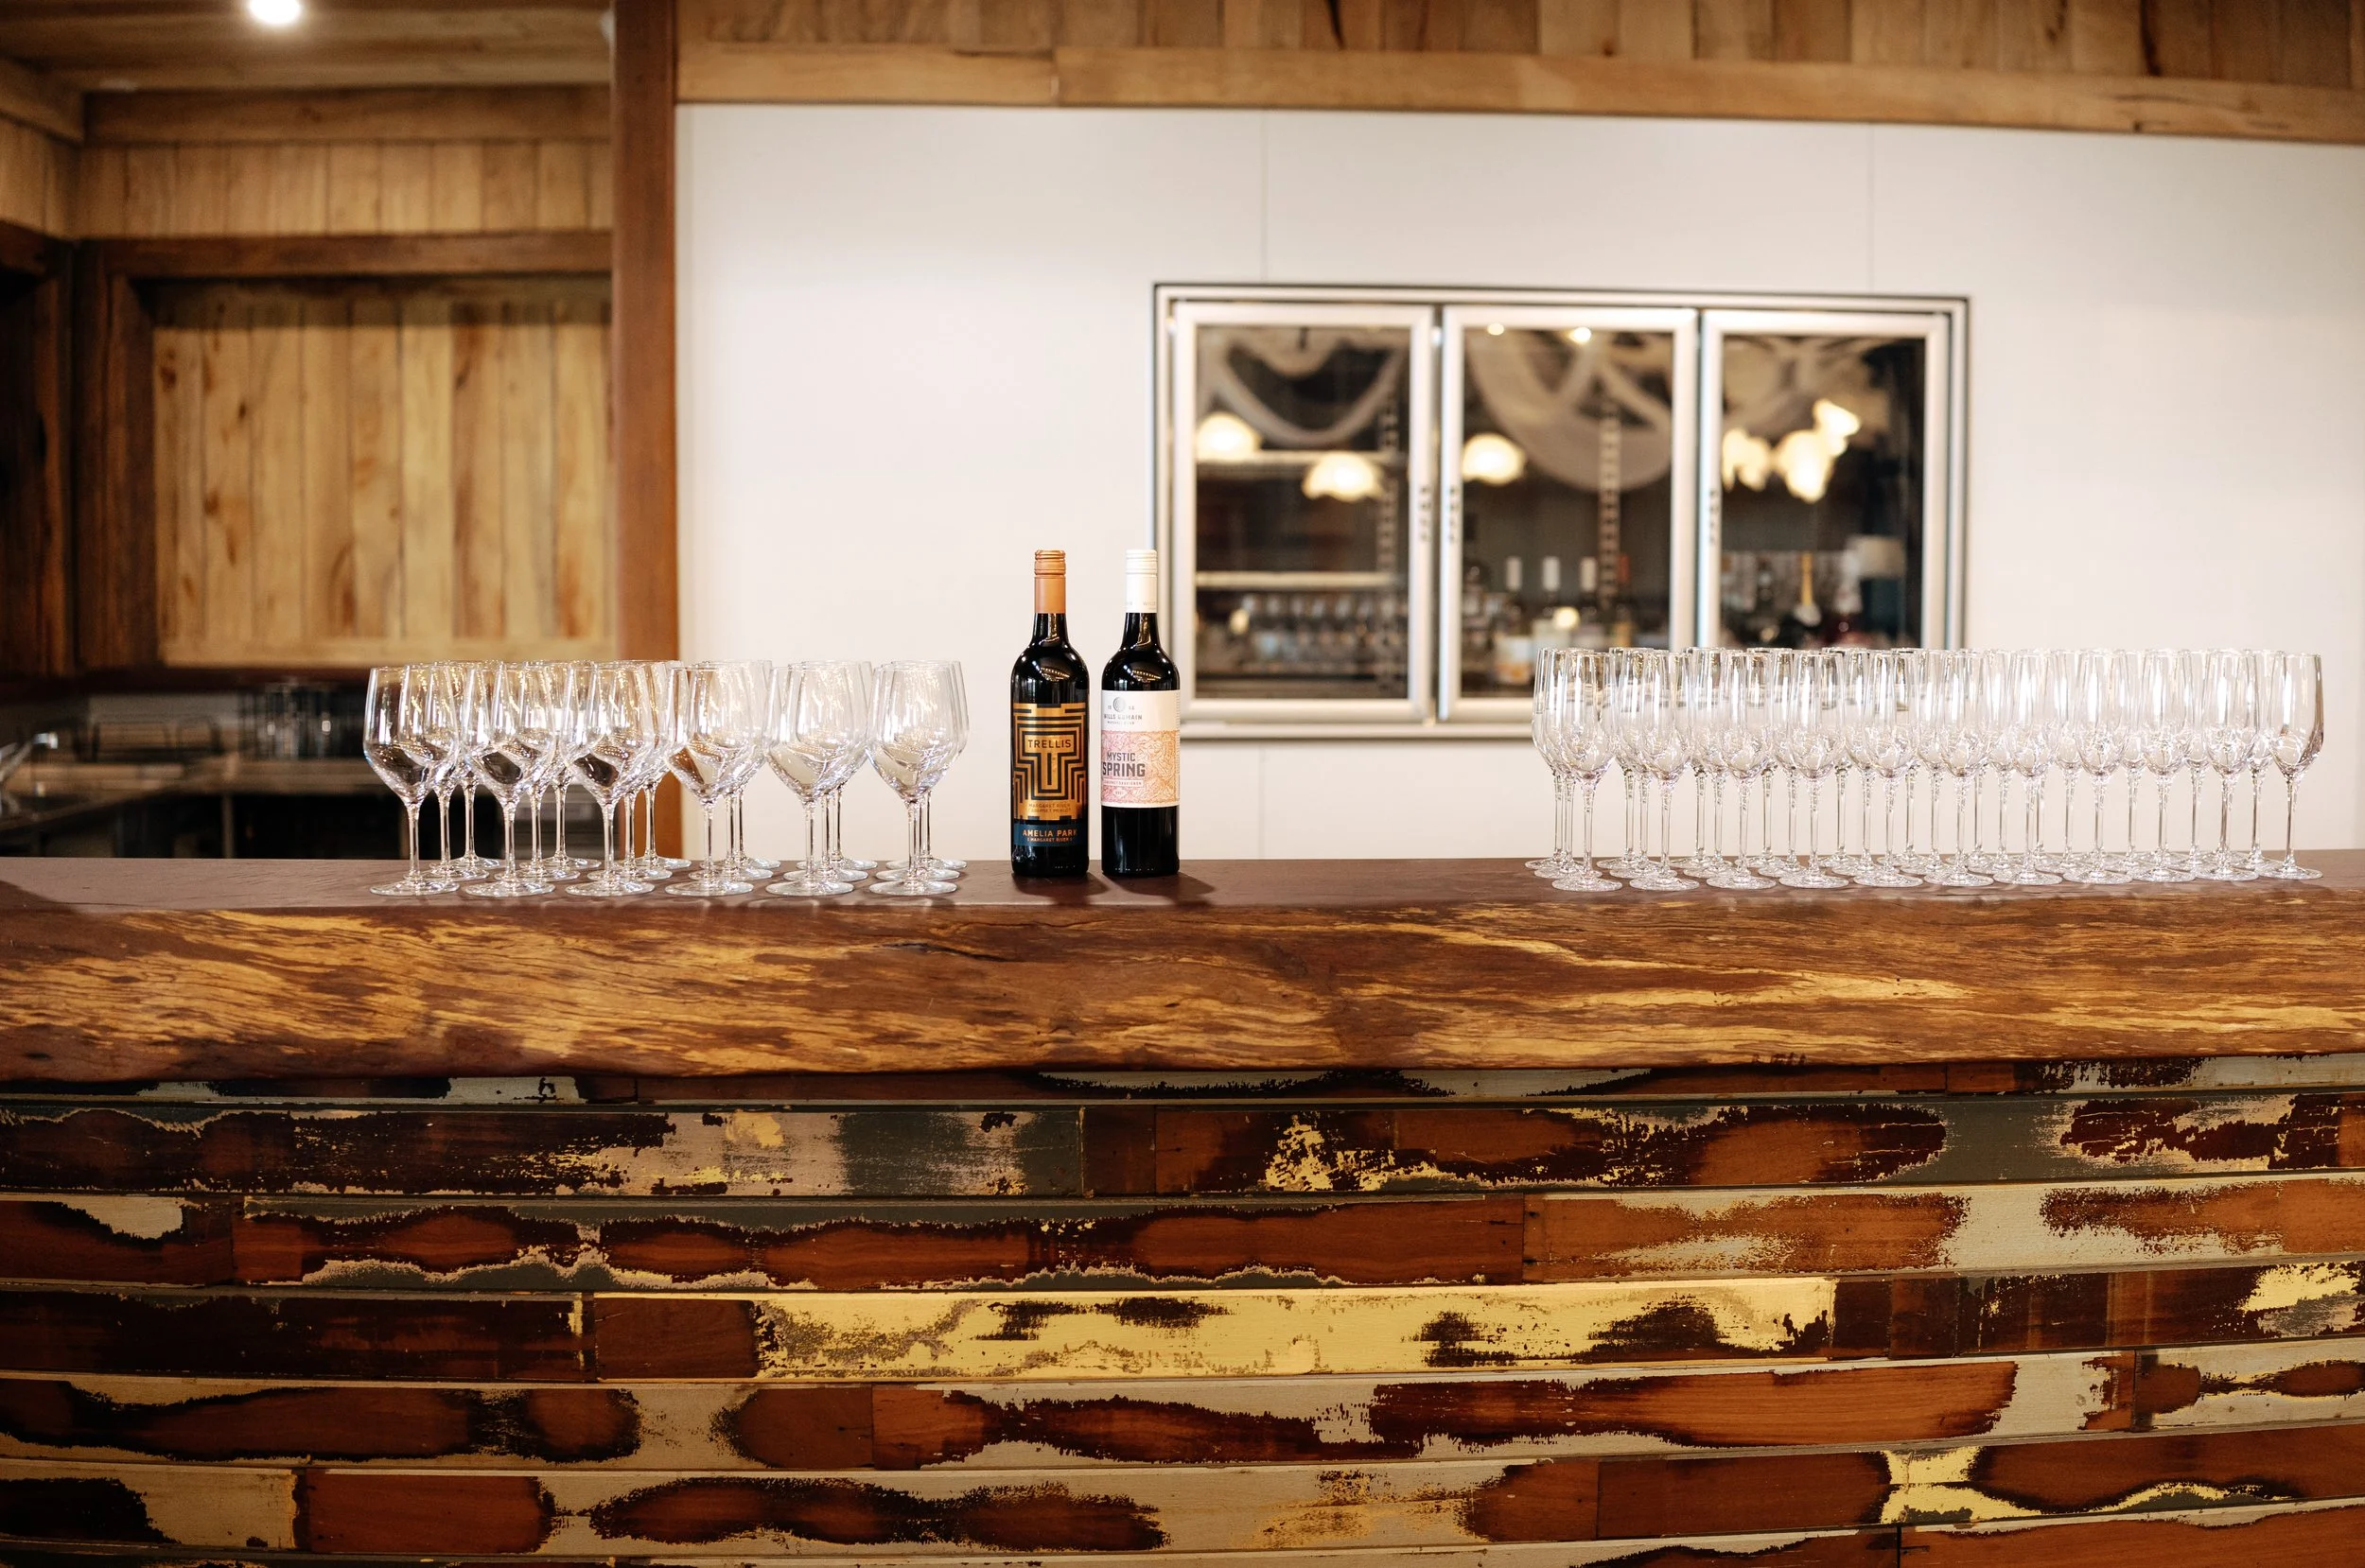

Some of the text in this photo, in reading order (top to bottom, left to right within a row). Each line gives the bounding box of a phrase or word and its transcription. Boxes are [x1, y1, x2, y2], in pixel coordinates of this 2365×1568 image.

[1027, 739, 1072, 749] TRELLIS
[1107, 752, 1136, 761] MYSTIC
[1102, 761, 1146, 777] SPRING
[1023, 828, 1054, 837] AMELIA
